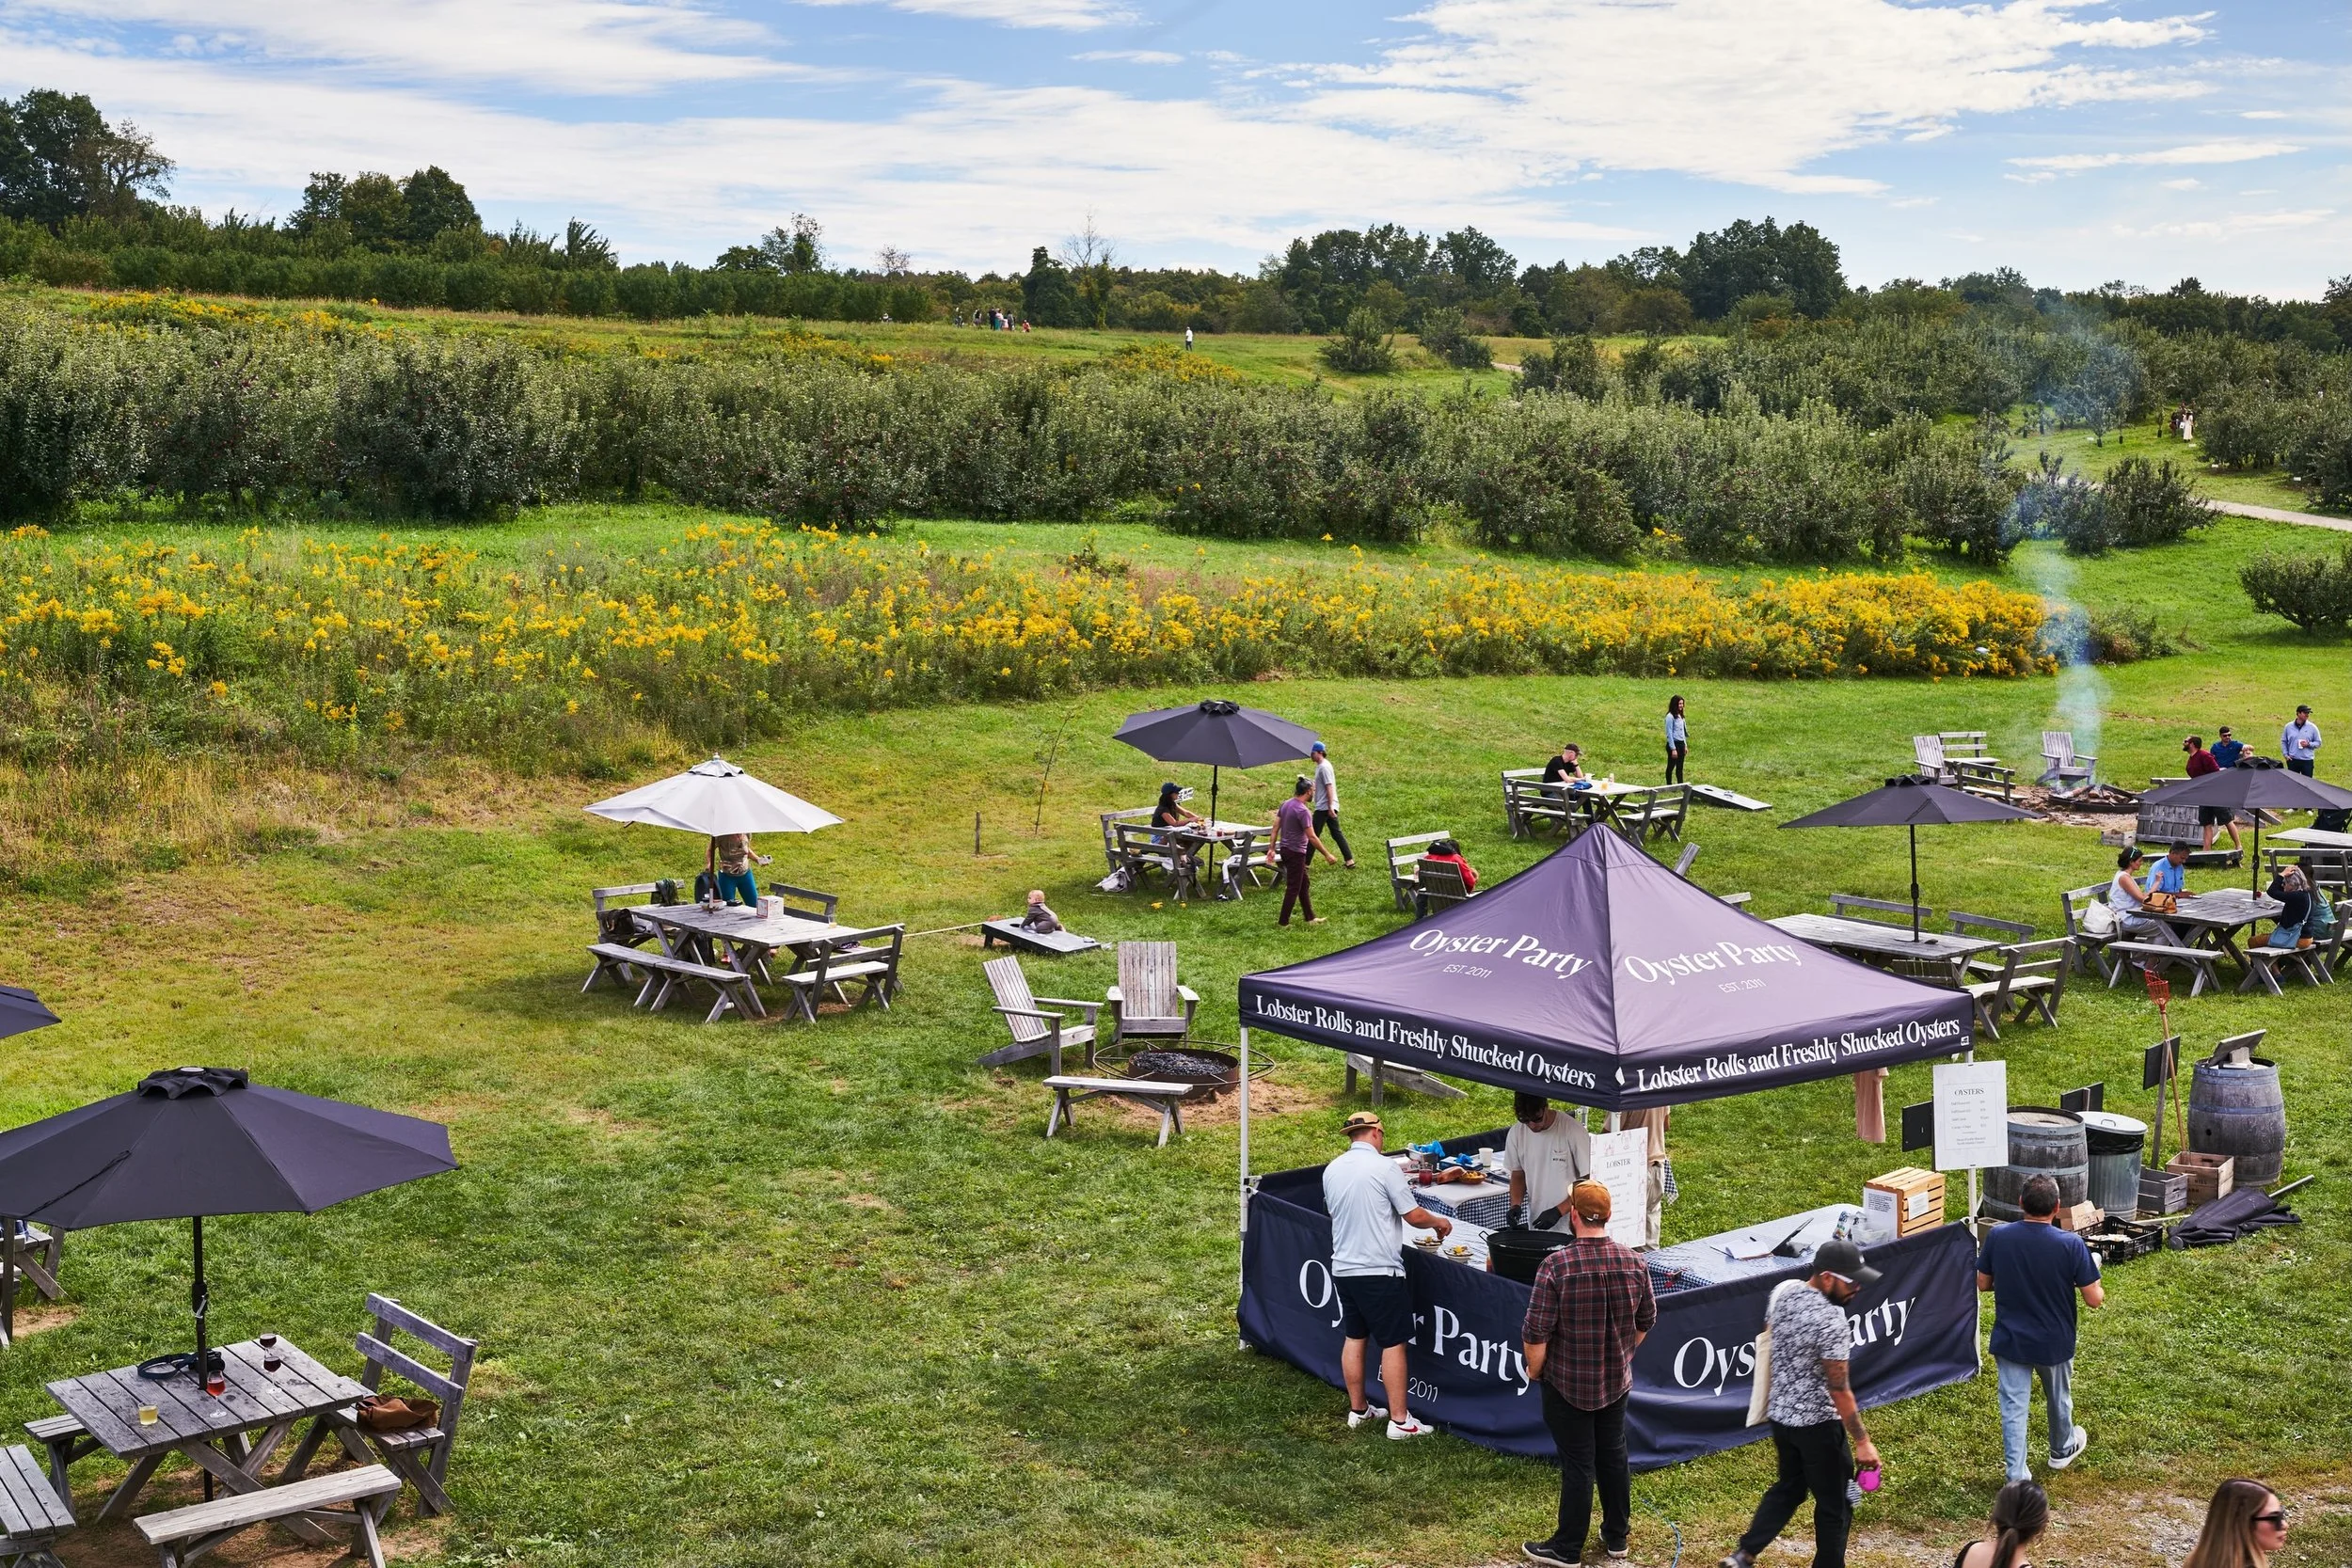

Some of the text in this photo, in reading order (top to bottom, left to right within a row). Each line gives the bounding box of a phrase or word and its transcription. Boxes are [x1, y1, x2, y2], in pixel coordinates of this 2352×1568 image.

[1409, 929, 1594, 979] Oyster Party
[1442, 964, 1493, 978] EST. 2011
[1624, 942, 1803, 986] Oyster Party
[1718, 978, 1767, 993] EST. 2011
[1256, 995, 1597, 1090] Lobster Rolls and Freshly Shucked Oysters
[1636, 1017, 1960, 1092] Lobster Rolls and Freshly Shucked Oysters
[1954, 1087, 1984, 1096] OYSTERS
[1606, 1158, 1631, 1168] LOBSTER
[1299, 1259, 1530, 1396] Oyr Party
[1673, 1297, 1916, 1397] Oys arty
[1407, 1376, 1438, 1402] 2011
